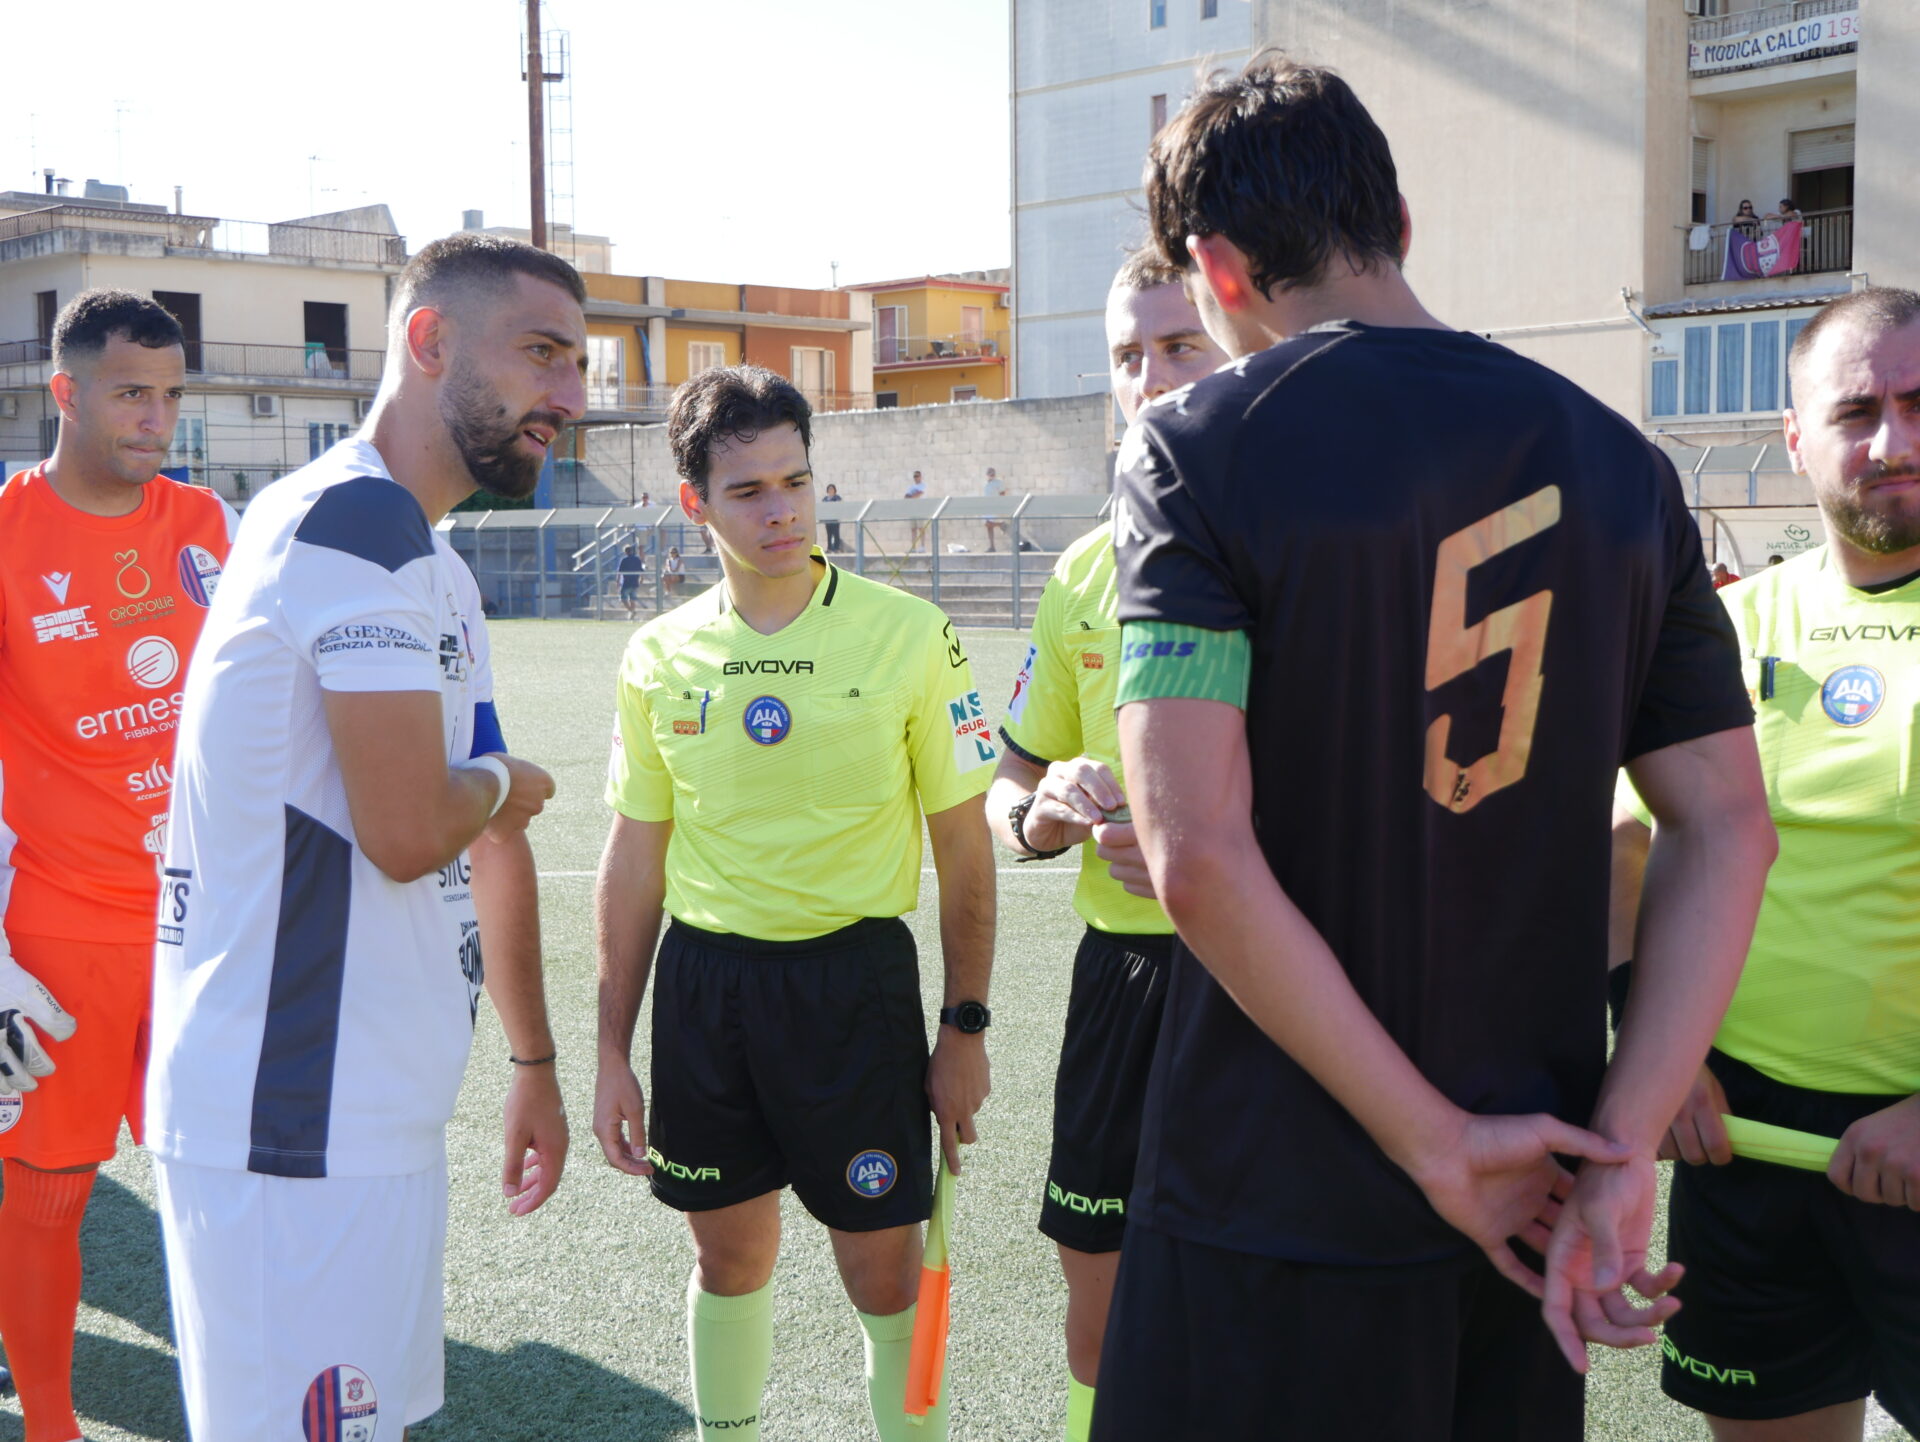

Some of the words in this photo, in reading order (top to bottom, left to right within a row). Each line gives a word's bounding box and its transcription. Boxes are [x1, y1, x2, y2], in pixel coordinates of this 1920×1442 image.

[1704, 39, 1762, 63] MODICA
[1766, 23, 1821, 52] CALCIO
[378, 640, 391, 649] DI
[1422, 484, 1562, 814] 5
[723, 660, 814, 675] GIVOVA
[1832, 678, 1874, 702] AIA
[76, 691, 185, 739] ermes
[751, 708, 783, 728] AIA
[124, 725, 158, 741] FIBRA
[649, 1146, 720, 1181] GIVOVA
[857, 1161, 889, 1182] AIA
[1048, 1179, 1124, 1215] GIVOVA
[1661, 1333, 1756, 1385] GIVOVA
[343, 1403, 376, 1413] MODICA
